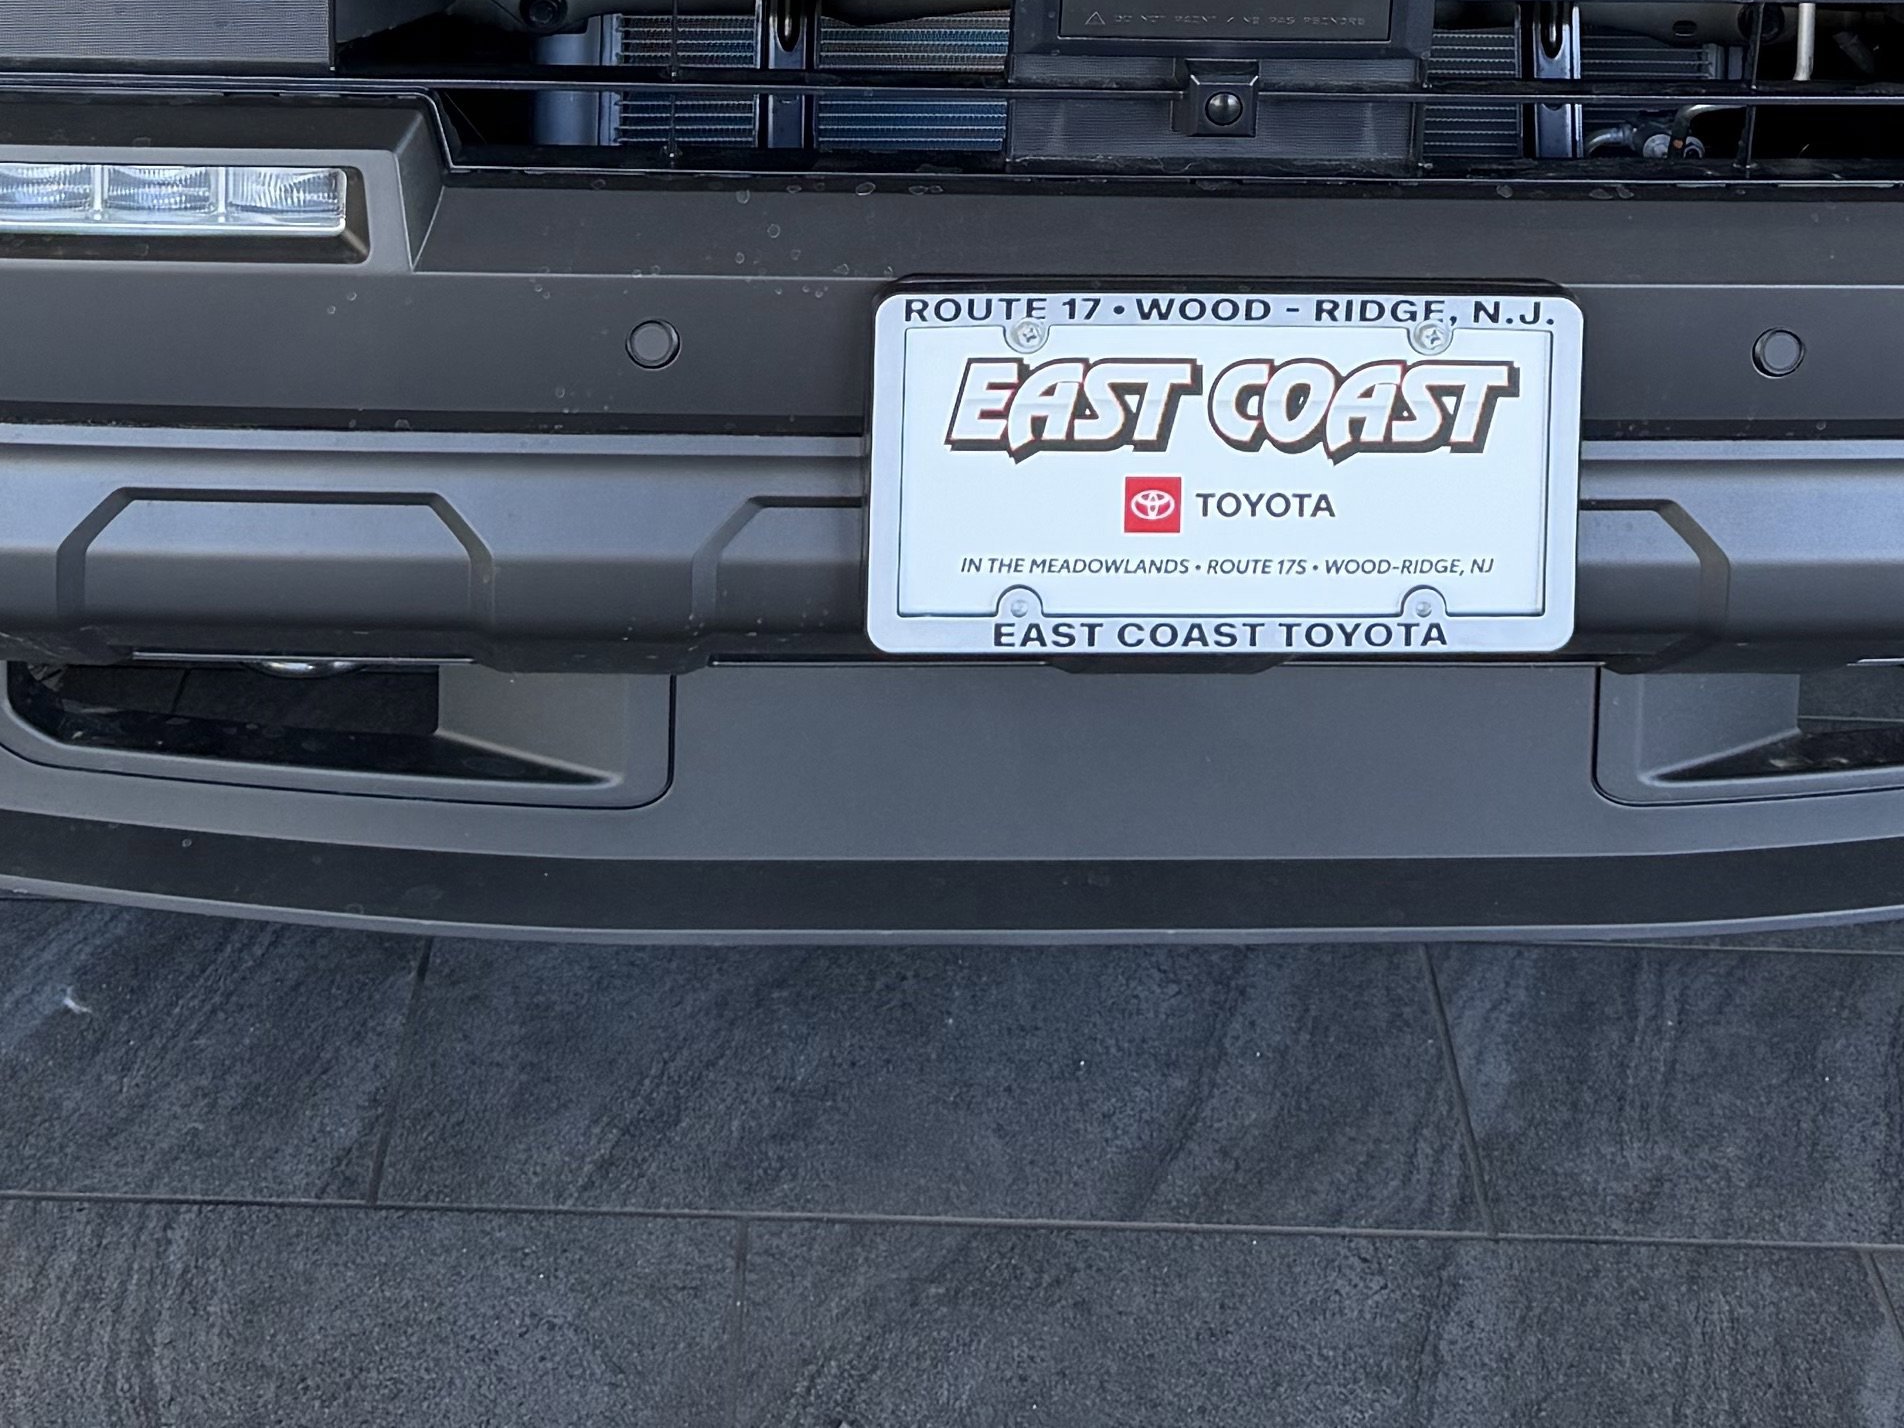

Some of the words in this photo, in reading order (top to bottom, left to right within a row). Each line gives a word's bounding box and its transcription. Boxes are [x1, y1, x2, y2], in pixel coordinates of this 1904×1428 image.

[904, 298, 1047, 323] ROUTE
[1062, 297, 1101, 322] 17
[1134, 298, 1273, 323] WOOD
[1314, 298, 1457, 328] RIDGE,
[1471, 300, 1558, 325] N.J.
[944, 357, 1203, 465] EAST
[1207, 357, 1521, 467] COAST
[1196, 492, 1336, 519] TOYOTA
[961, 557, 983, 573] IN
[987, 557, 1026, 573] THE
[1028, 558, 1190, 574] MEADOWLANDS
[1206, 558, 1273, 574] ROUTE
[1324, 558, 1465, 576] WOOD-RIDGE,
[1469, 558, 1495, 574] NJ
[993, 621, 1105, 649] EAST
[1116, 621, 1267, 649] COAST
[1278, 621, 1449, 649] TOYOTA
